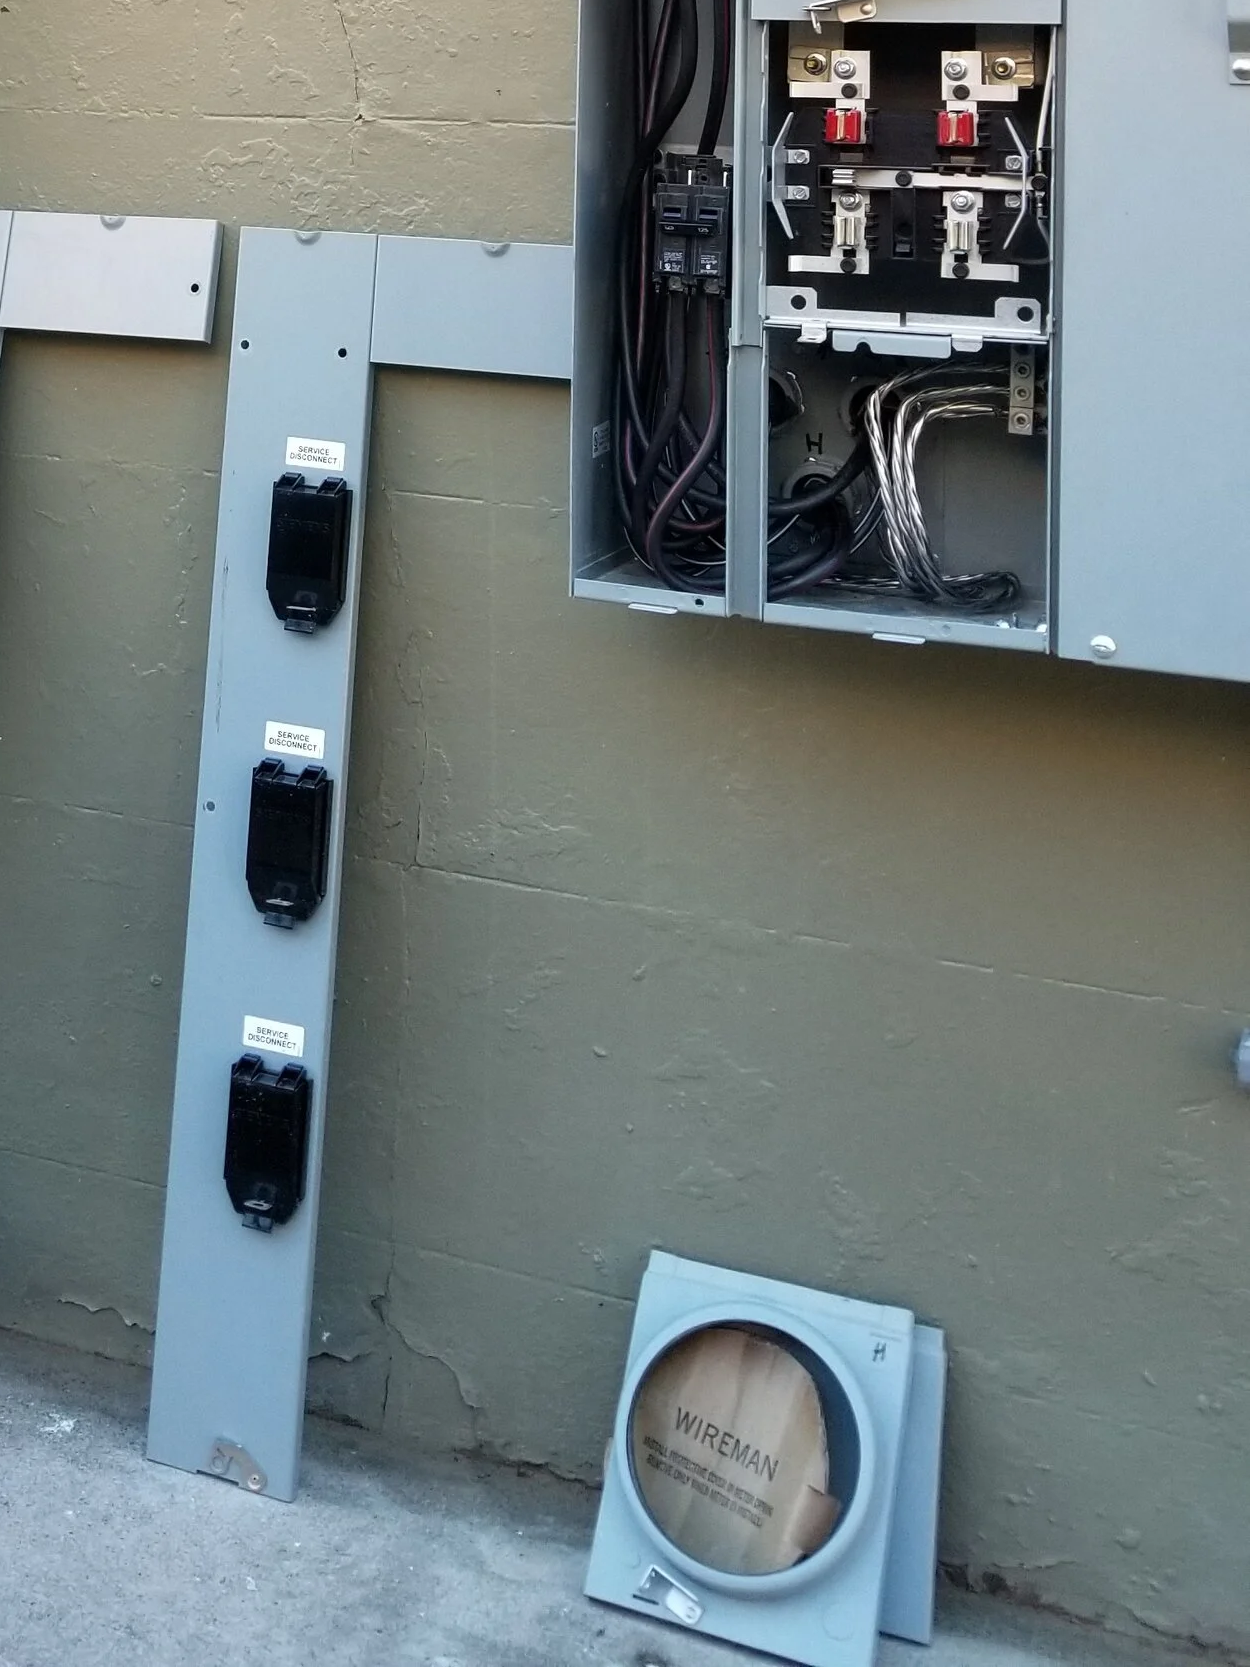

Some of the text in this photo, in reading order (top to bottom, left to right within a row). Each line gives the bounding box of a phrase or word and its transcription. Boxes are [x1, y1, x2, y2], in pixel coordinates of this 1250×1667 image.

[298, 445, 330, 456] SERVICE
[805, 432, 823, 455] H
[289, 452, 338, 465] DISCONNECT
[277, 730, 310, 743] SERVICE
[268, 737, 318, 752] DISCONNECT
[256, 1026, 289, 1040] SERVICE
[247, 1032, 297, 1050] DISCONNECT
[674, 1406, 780, 1482] WIREMAN
